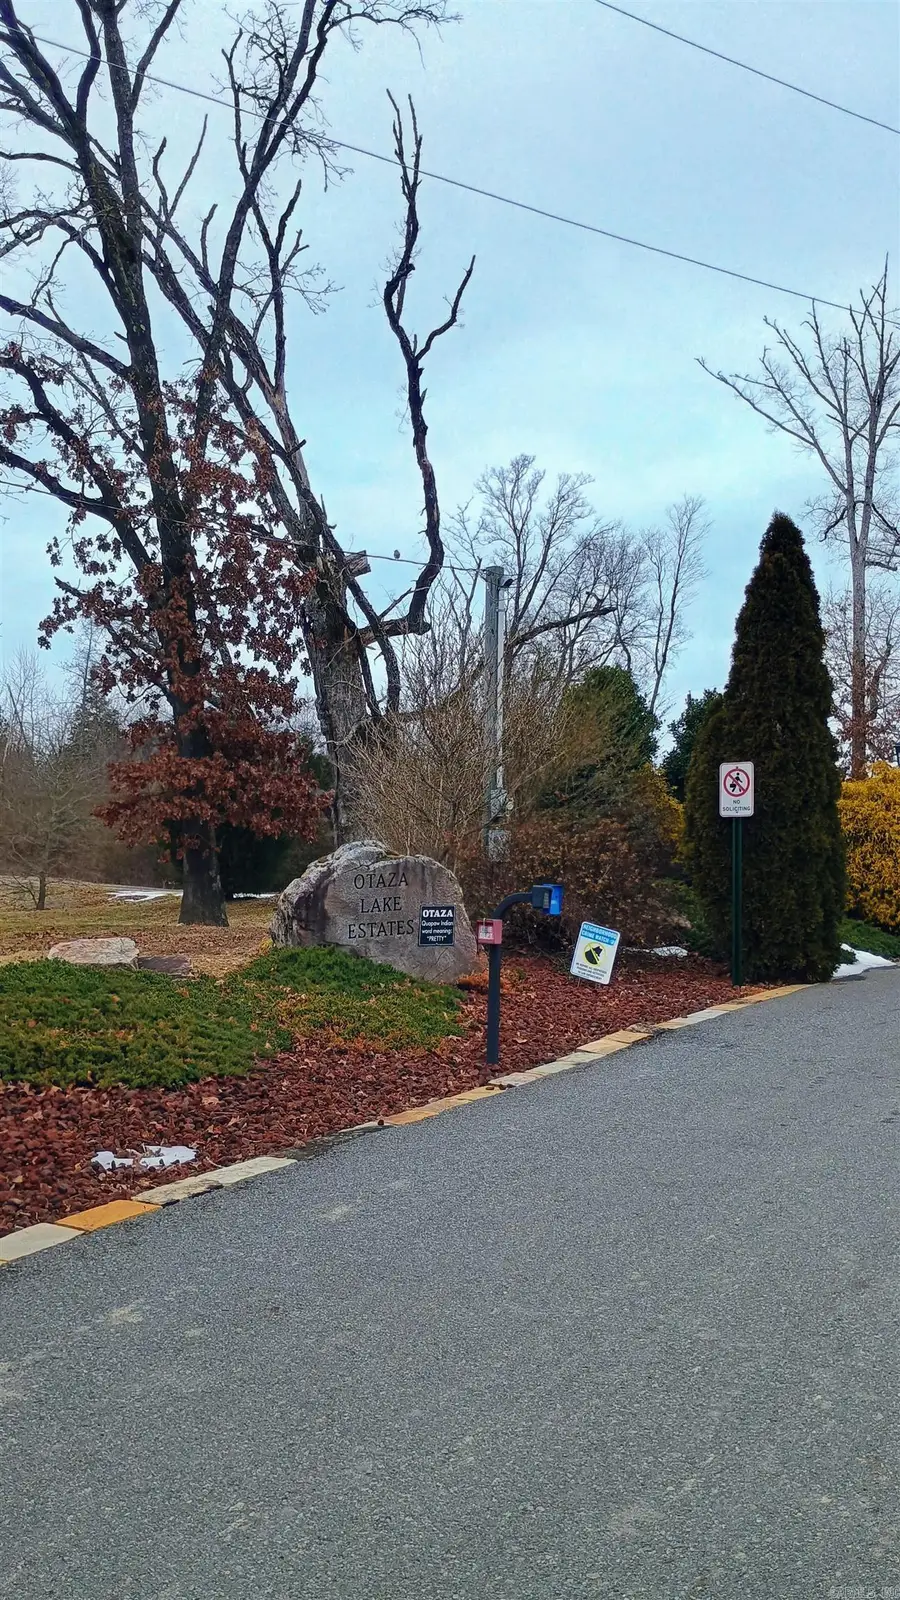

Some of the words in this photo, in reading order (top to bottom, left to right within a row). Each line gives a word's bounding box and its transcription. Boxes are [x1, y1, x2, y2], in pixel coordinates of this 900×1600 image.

[354, 872, 409, 889] OTAZA
[361, 896, 402, 913] LAKE
[422, 910, 454, 918] OTAZA
[348, 920, 414, 939] ESTATES
